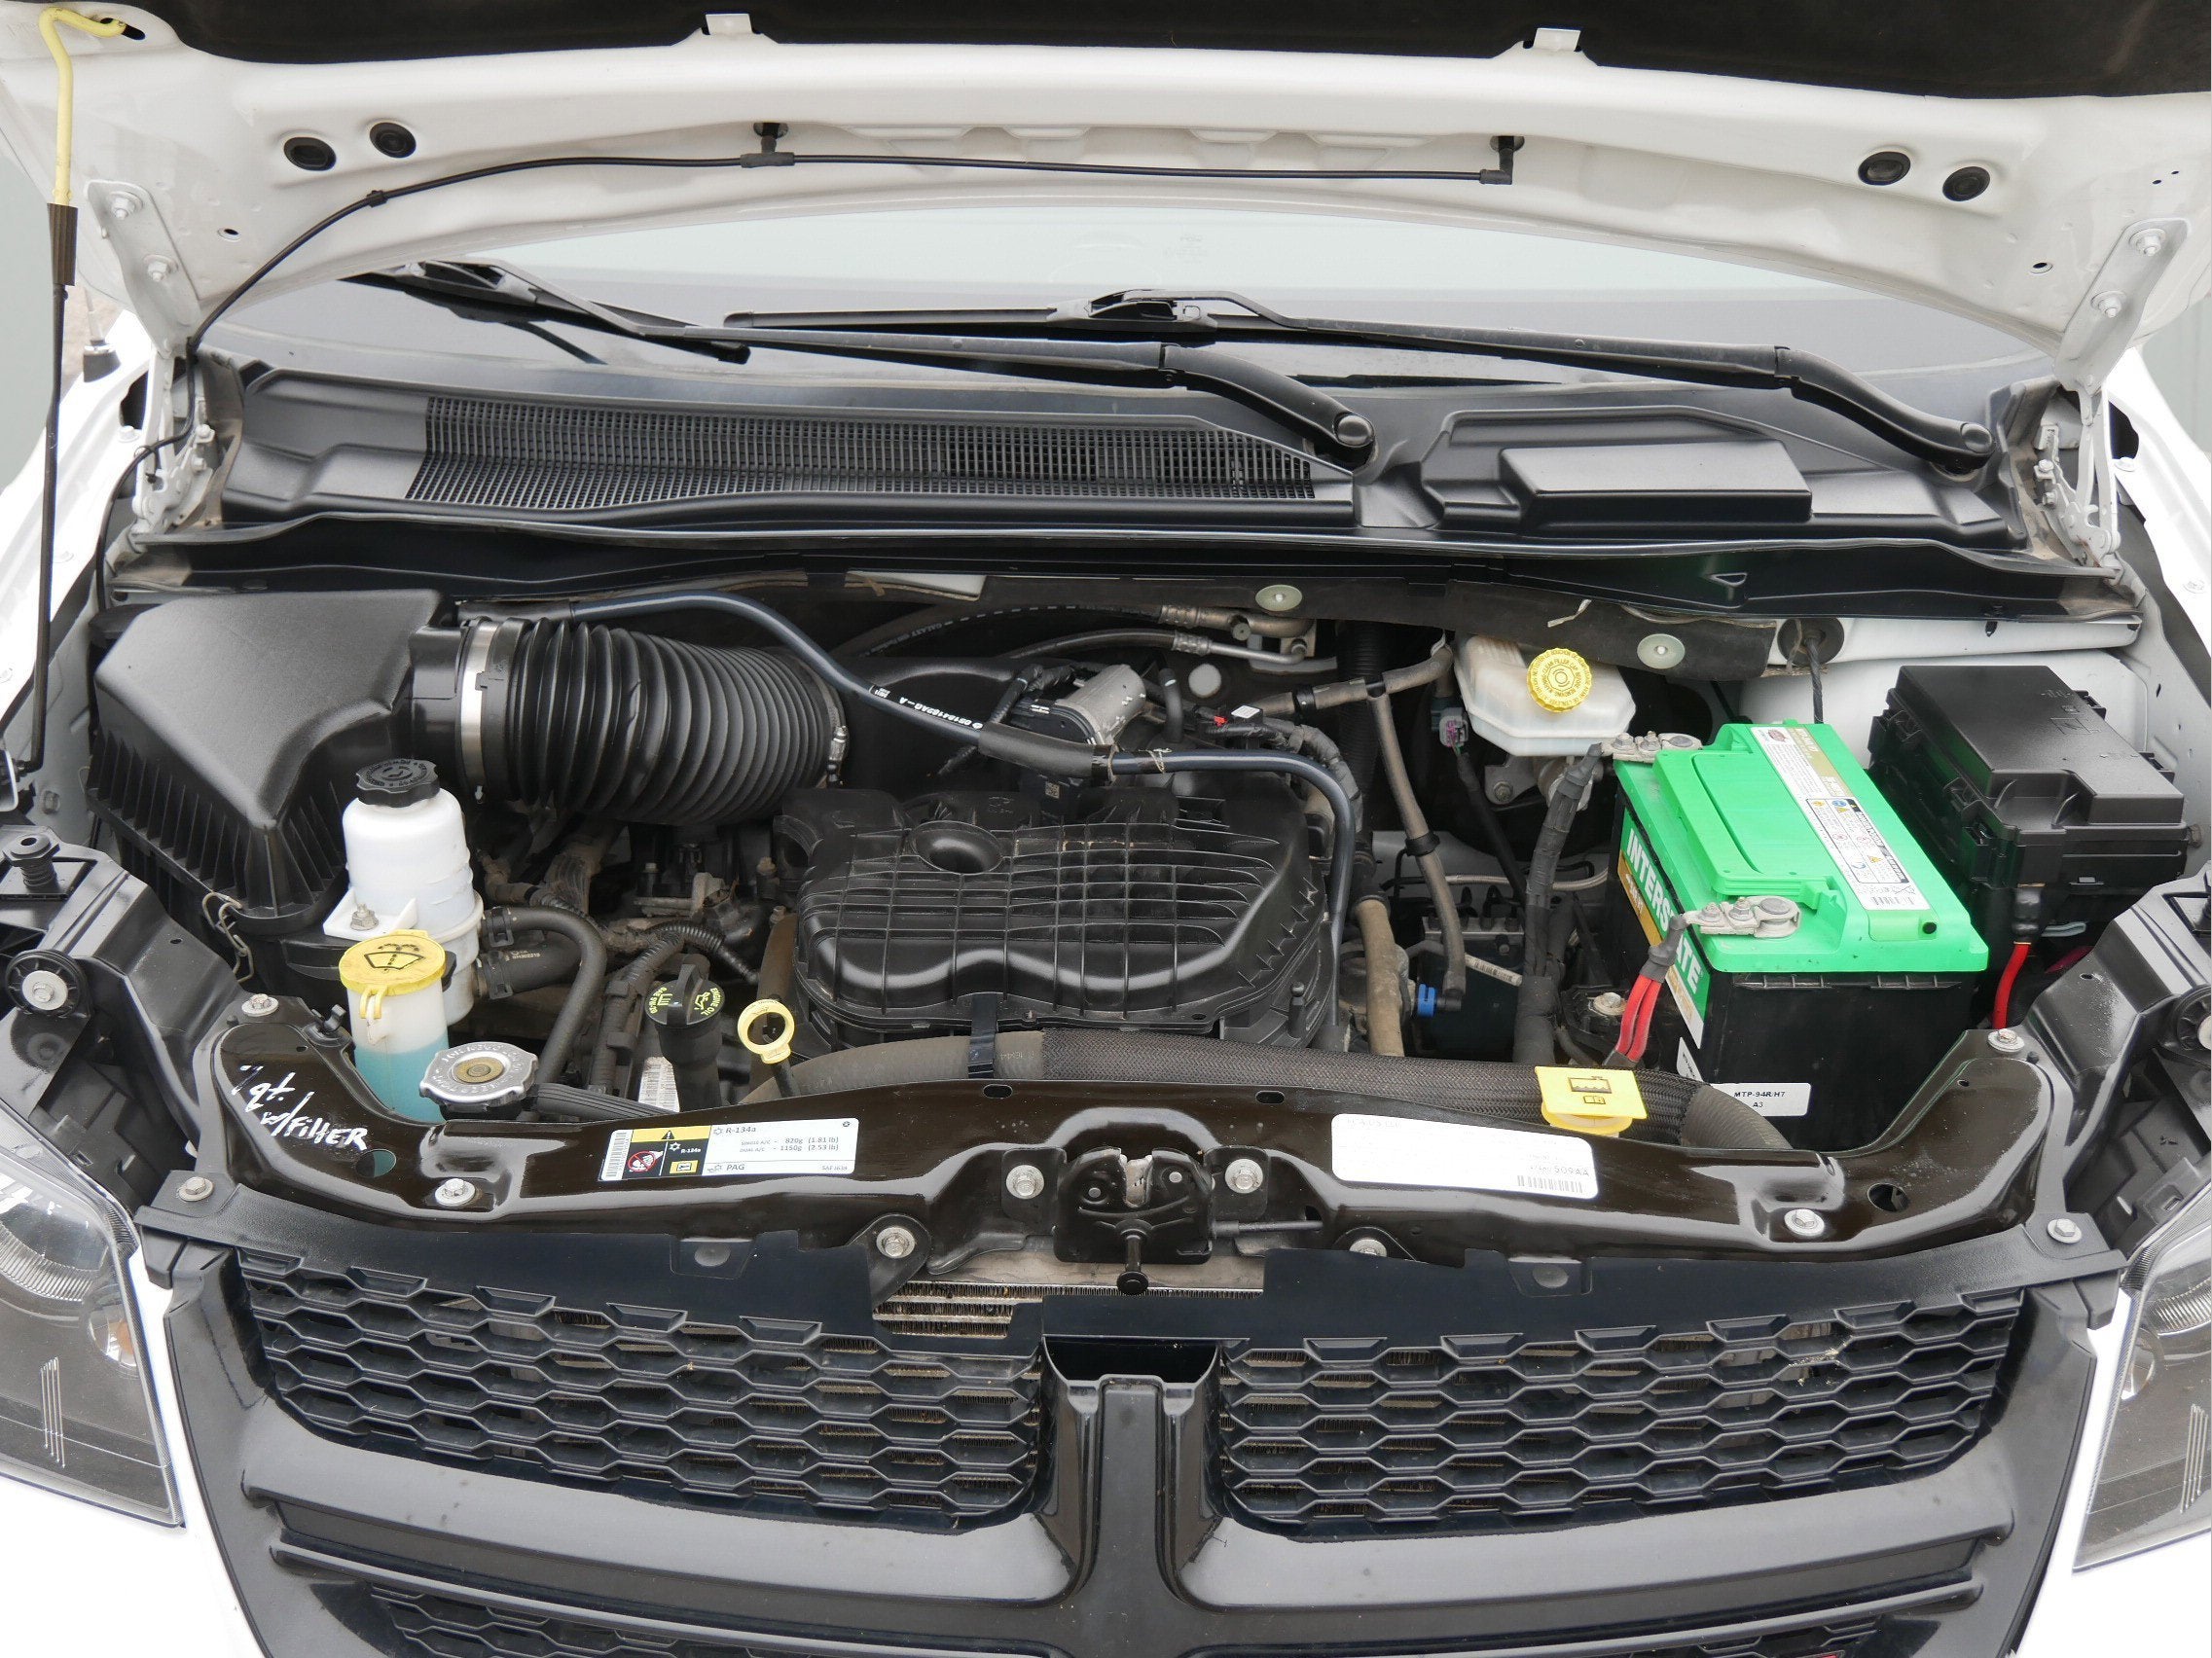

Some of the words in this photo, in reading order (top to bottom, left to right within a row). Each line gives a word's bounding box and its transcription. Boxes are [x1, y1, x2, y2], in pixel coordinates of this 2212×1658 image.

[710, 988, 722, 1007] ENGINE
[701, 1007, 715, 1016] OIL
[725, 1126, 757, 1135] R-134a
[726, 1163, 745, 1171] PAG
